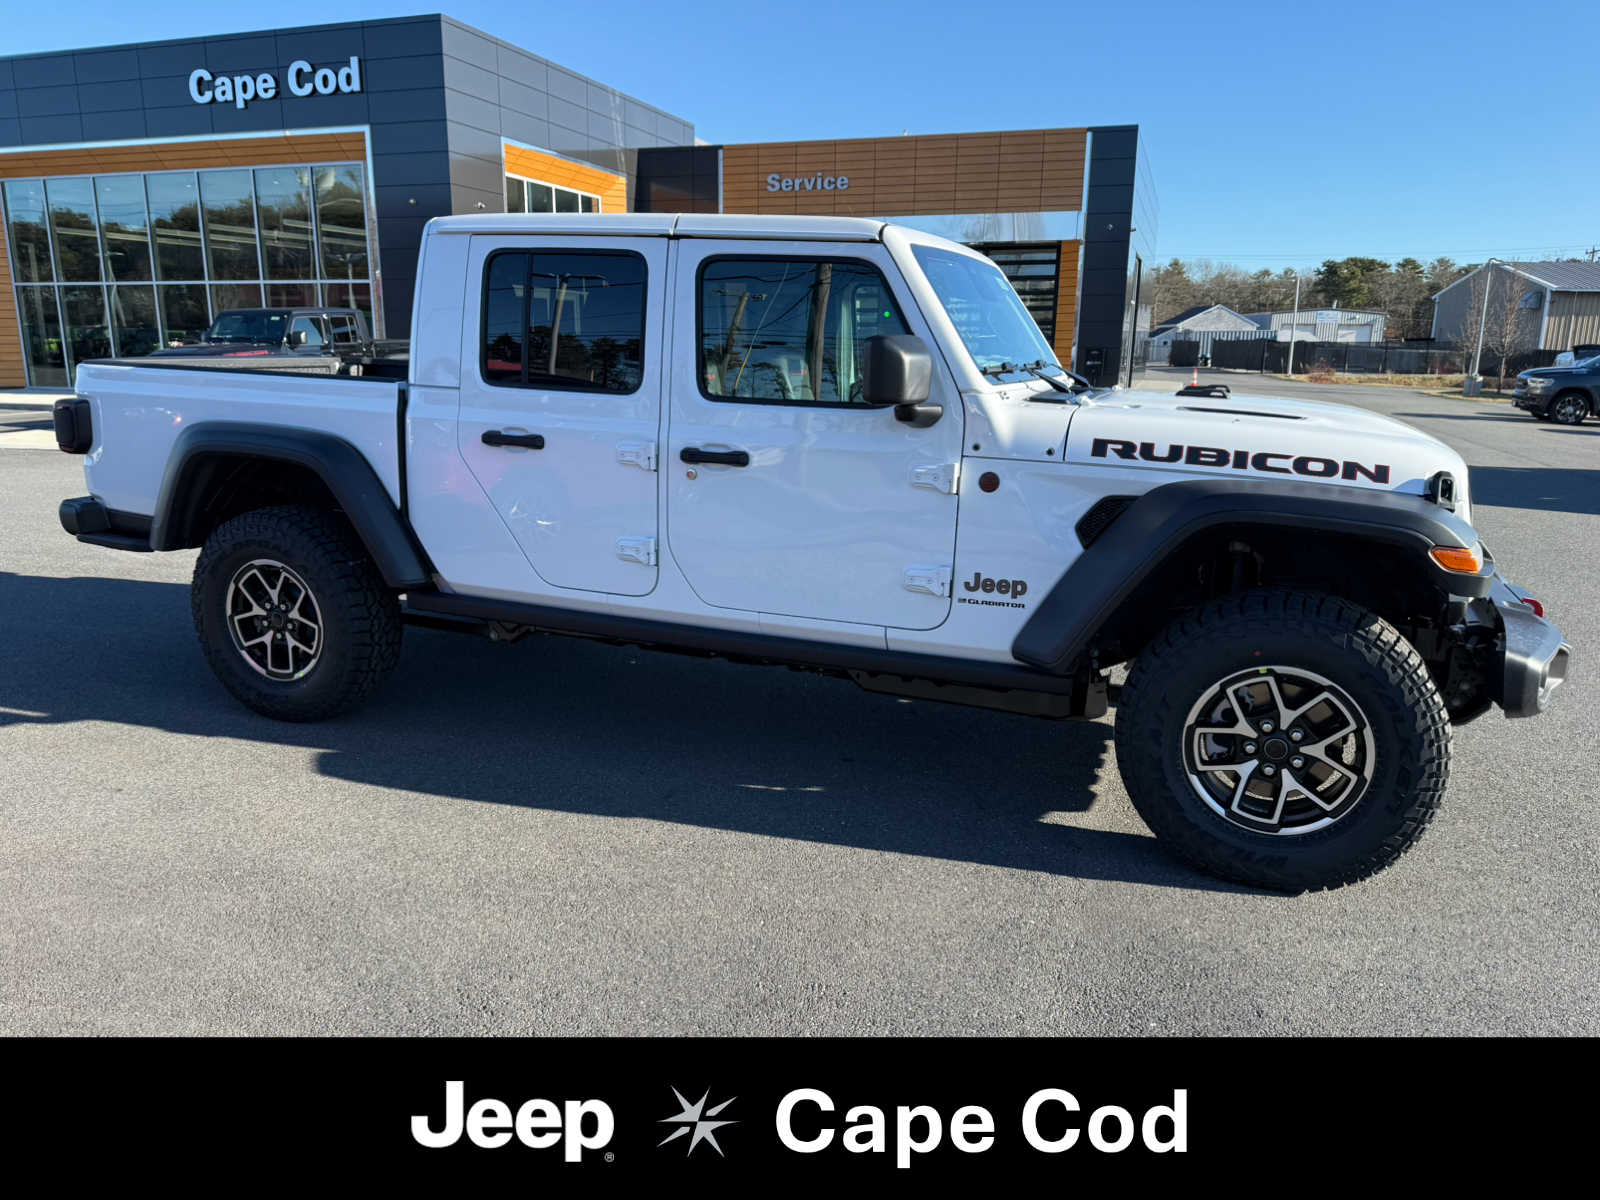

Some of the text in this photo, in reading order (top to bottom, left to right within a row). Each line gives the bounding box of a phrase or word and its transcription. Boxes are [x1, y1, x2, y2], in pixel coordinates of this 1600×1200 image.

[188, 56, 362, 109] Cape Cod
[767, 172, 849, 192] Service
[1091, 437, 1391, 484] RUBICON
[964, 572, 1028, 599] Jeep
[967, 598, 1026, 609] GLADIATOR
